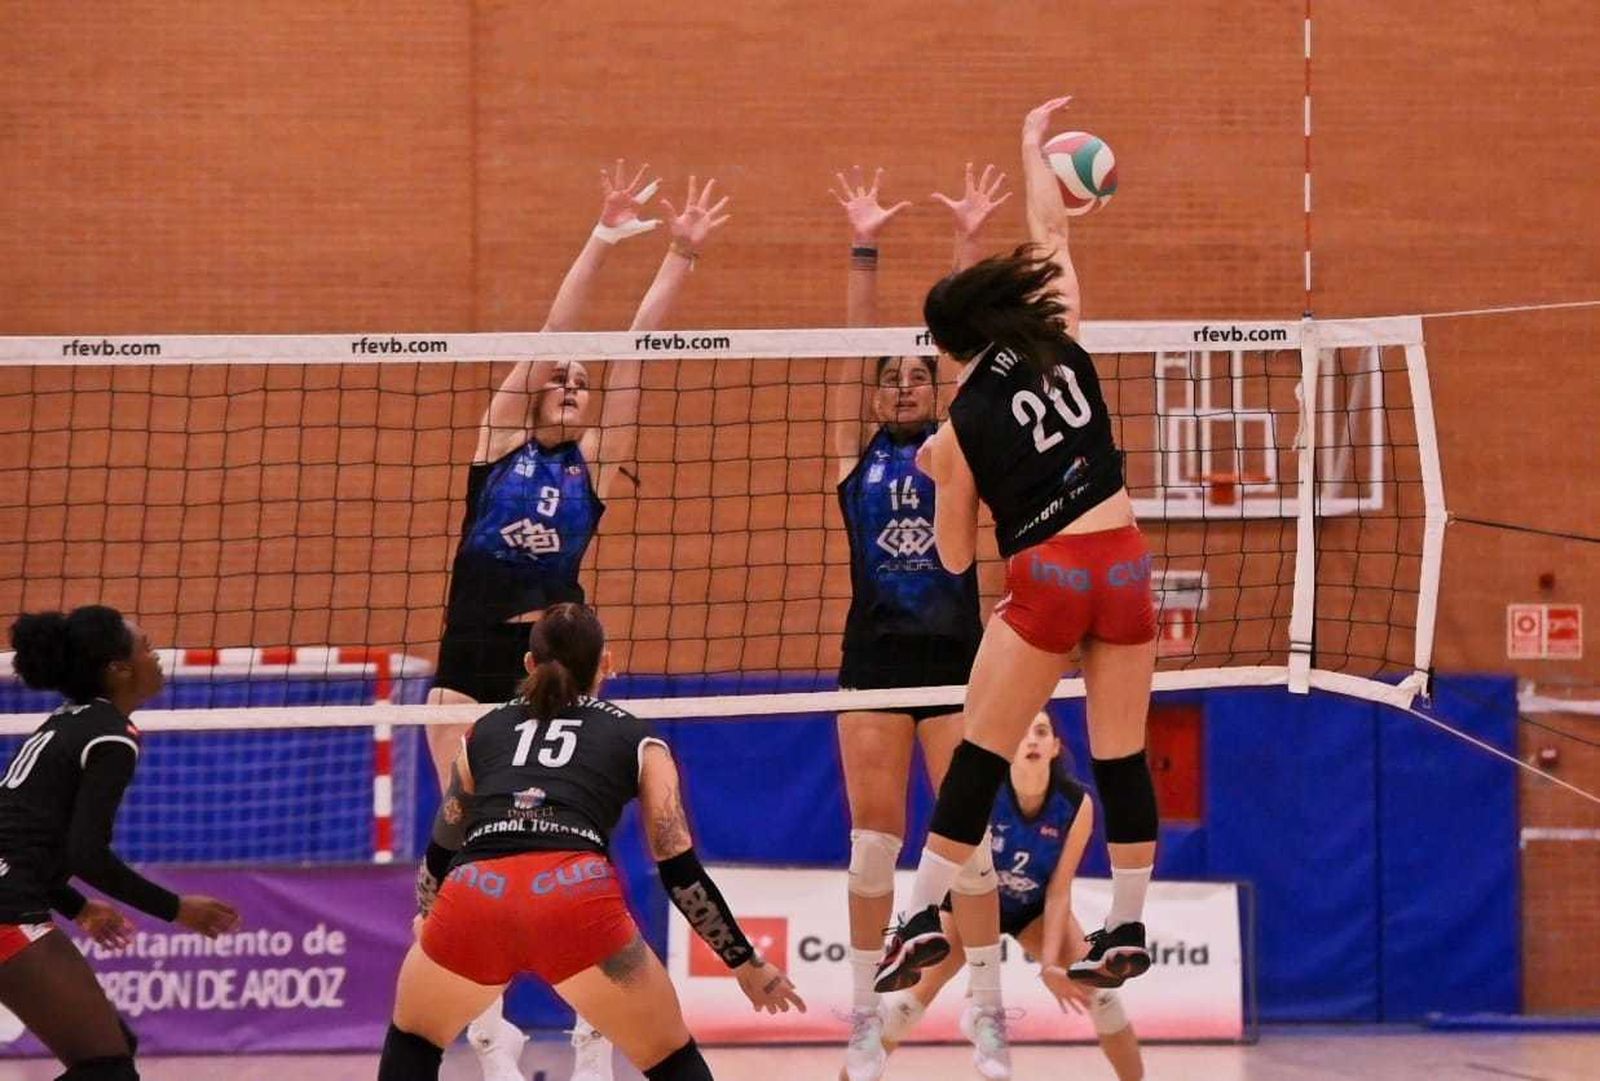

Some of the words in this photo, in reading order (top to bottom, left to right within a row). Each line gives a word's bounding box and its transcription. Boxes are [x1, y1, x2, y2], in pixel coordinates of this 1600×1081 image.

[352, 337, 447, 353] rfevb.com
[635, 334, 730, 350] rfevb.com
[1193, 326, 1287, 342] rfevb.com
[62, 339, 161, 356] rfevb.com
[1012, 364, 1092, 453] 20
[889, 475, 919, 511] 14
[512, 719, 583, 767] 15
[1011, 850, 1030, 875] 2
[302, 923, 346, 955] de
[1146, 940, 1209, 965] drid
[196, 968, 240, 1010] DE
[240, 966, 347, 1009] ARDOZ
